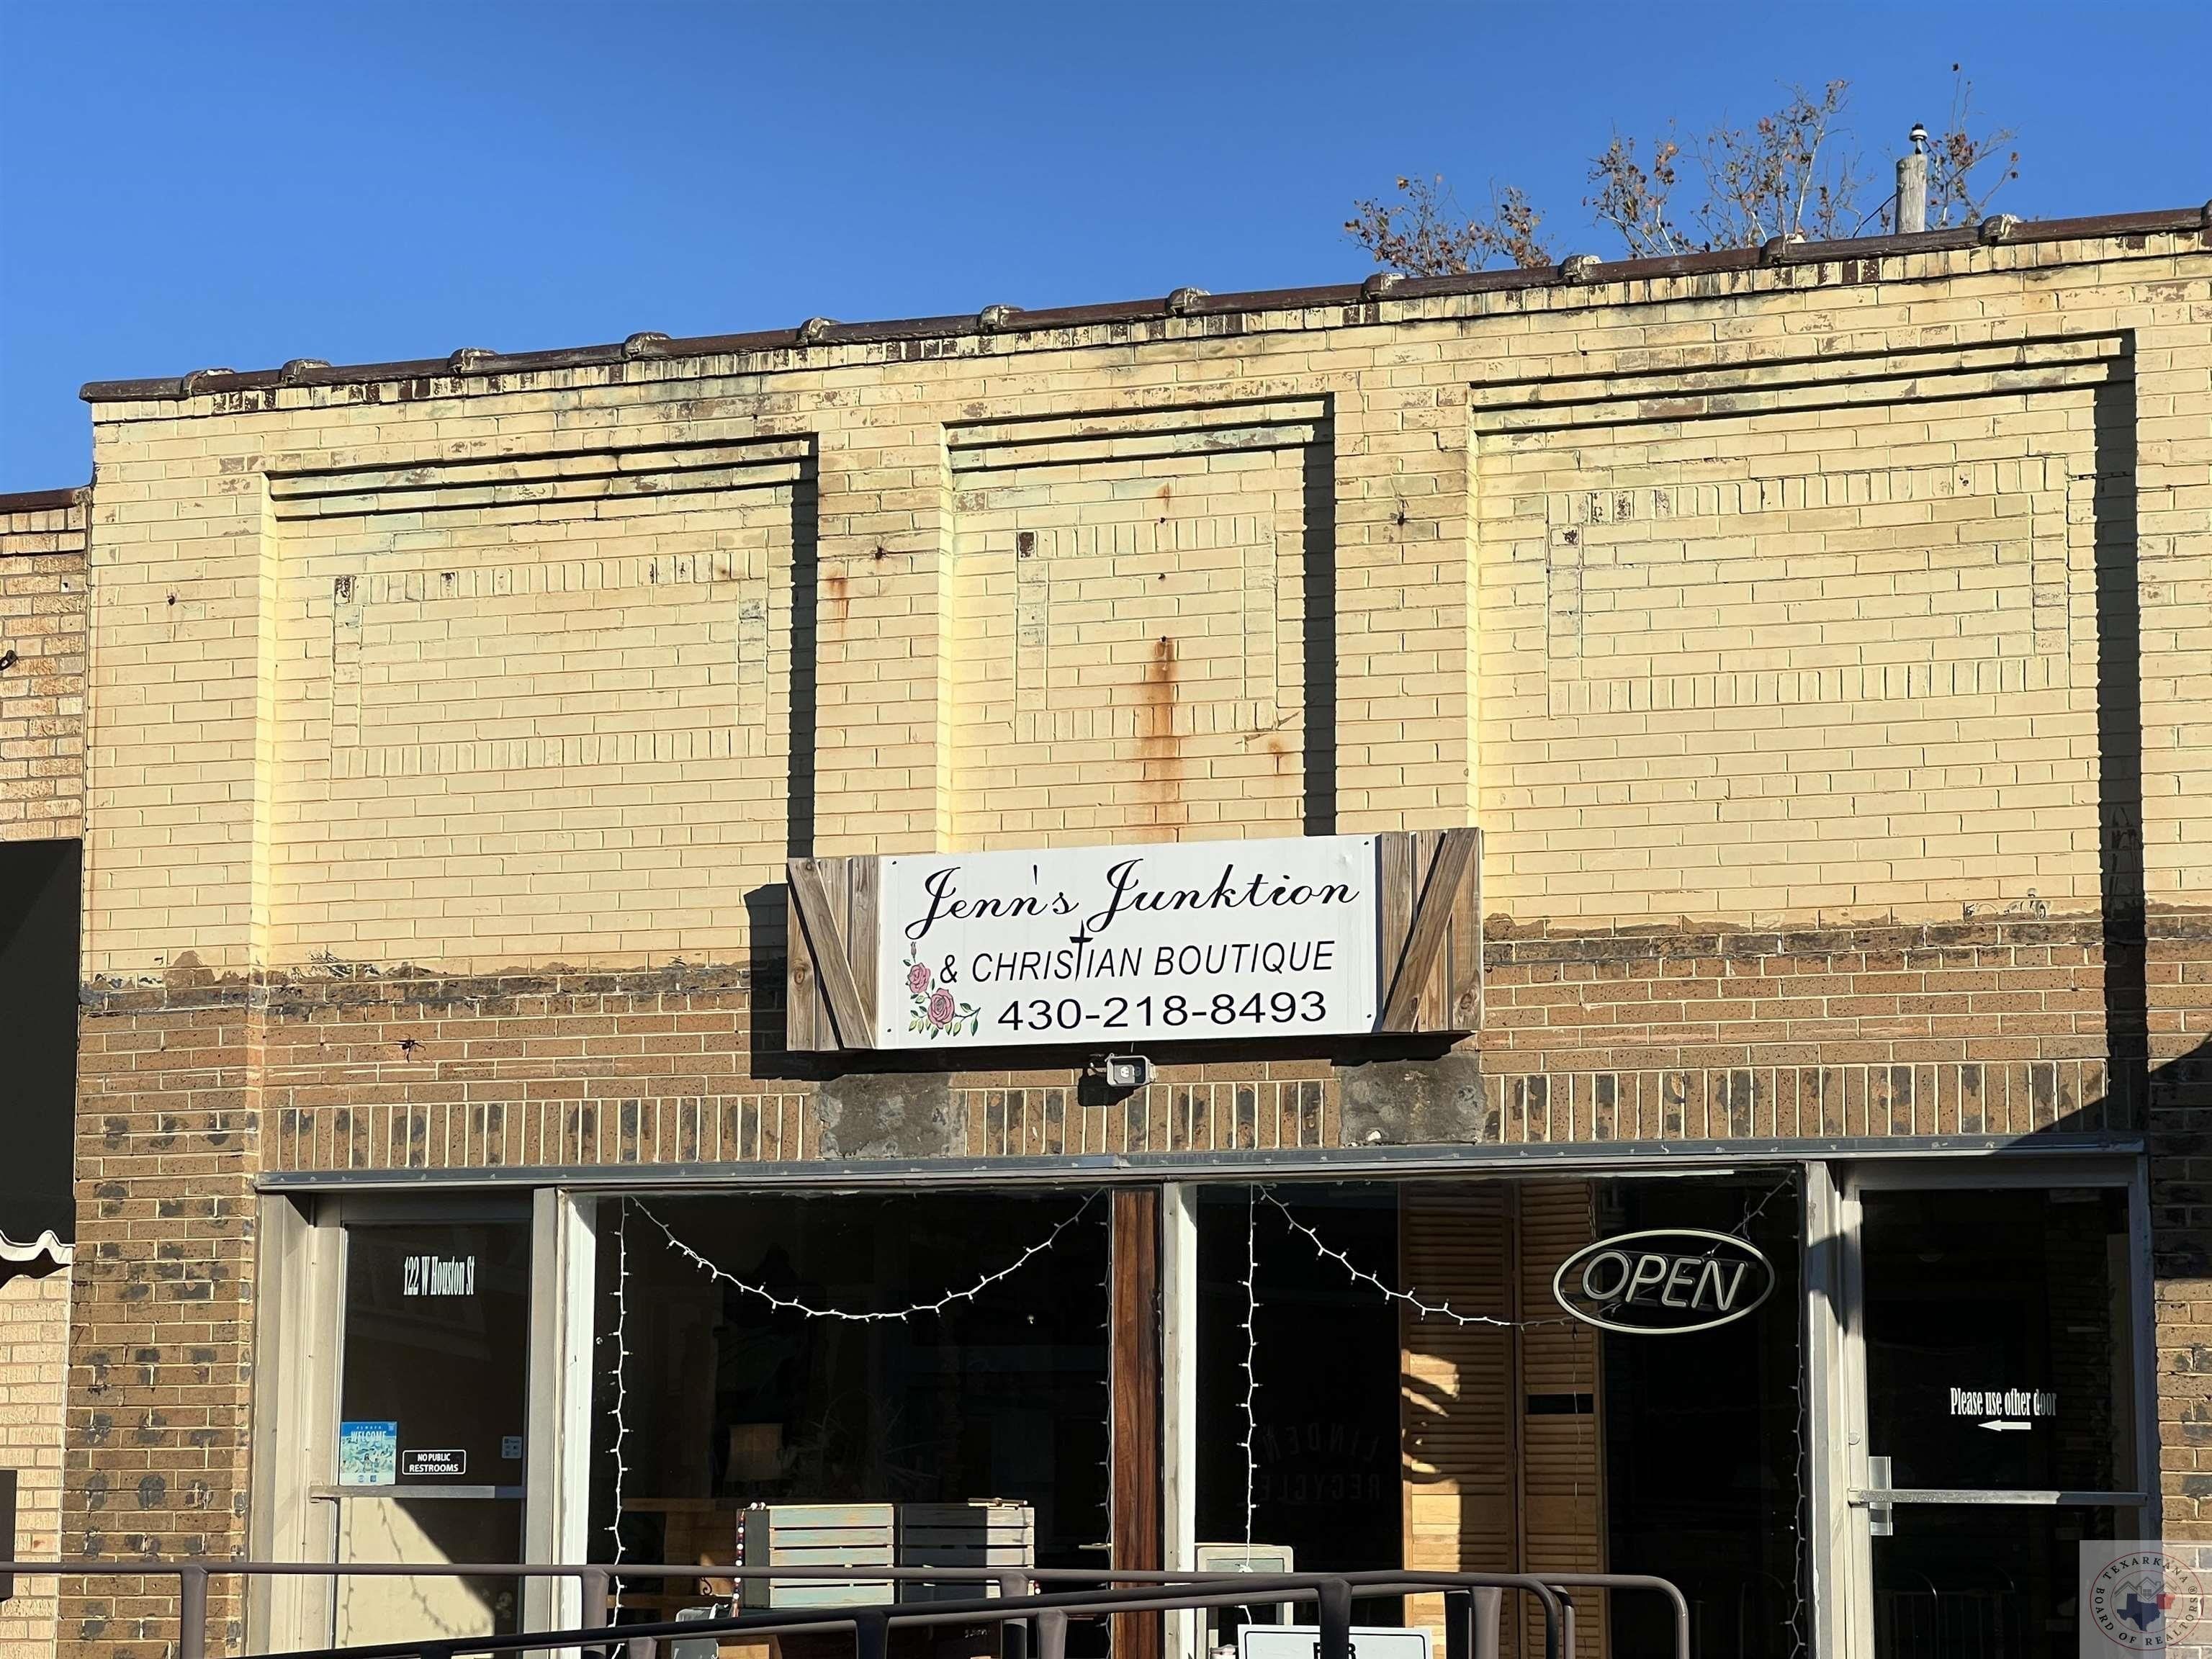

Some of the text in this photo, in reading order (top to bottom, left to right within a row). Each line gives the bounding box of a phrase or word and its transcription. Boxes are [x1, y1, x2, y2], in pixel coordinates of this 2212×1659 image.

[904, 858, 1359, 940] Jenn's Junktion
[940, 919, 1335, 984] & CHRISTIAN BOUTIQUE
[997, 990, 1326, 1031] 430-218-8493
[403, 1256, 475, 1295] 122 W Houston St
[1583, 1251, 1748, 1311] OPEN
[1950, 1387, 2057, 1416] Please use other door
[351, 1431, 387, 1442] WELCOME
[409, 1464, 459, 1473] RESTROOMS
[417, 1453, 451, 1462] NO PUBLIC
